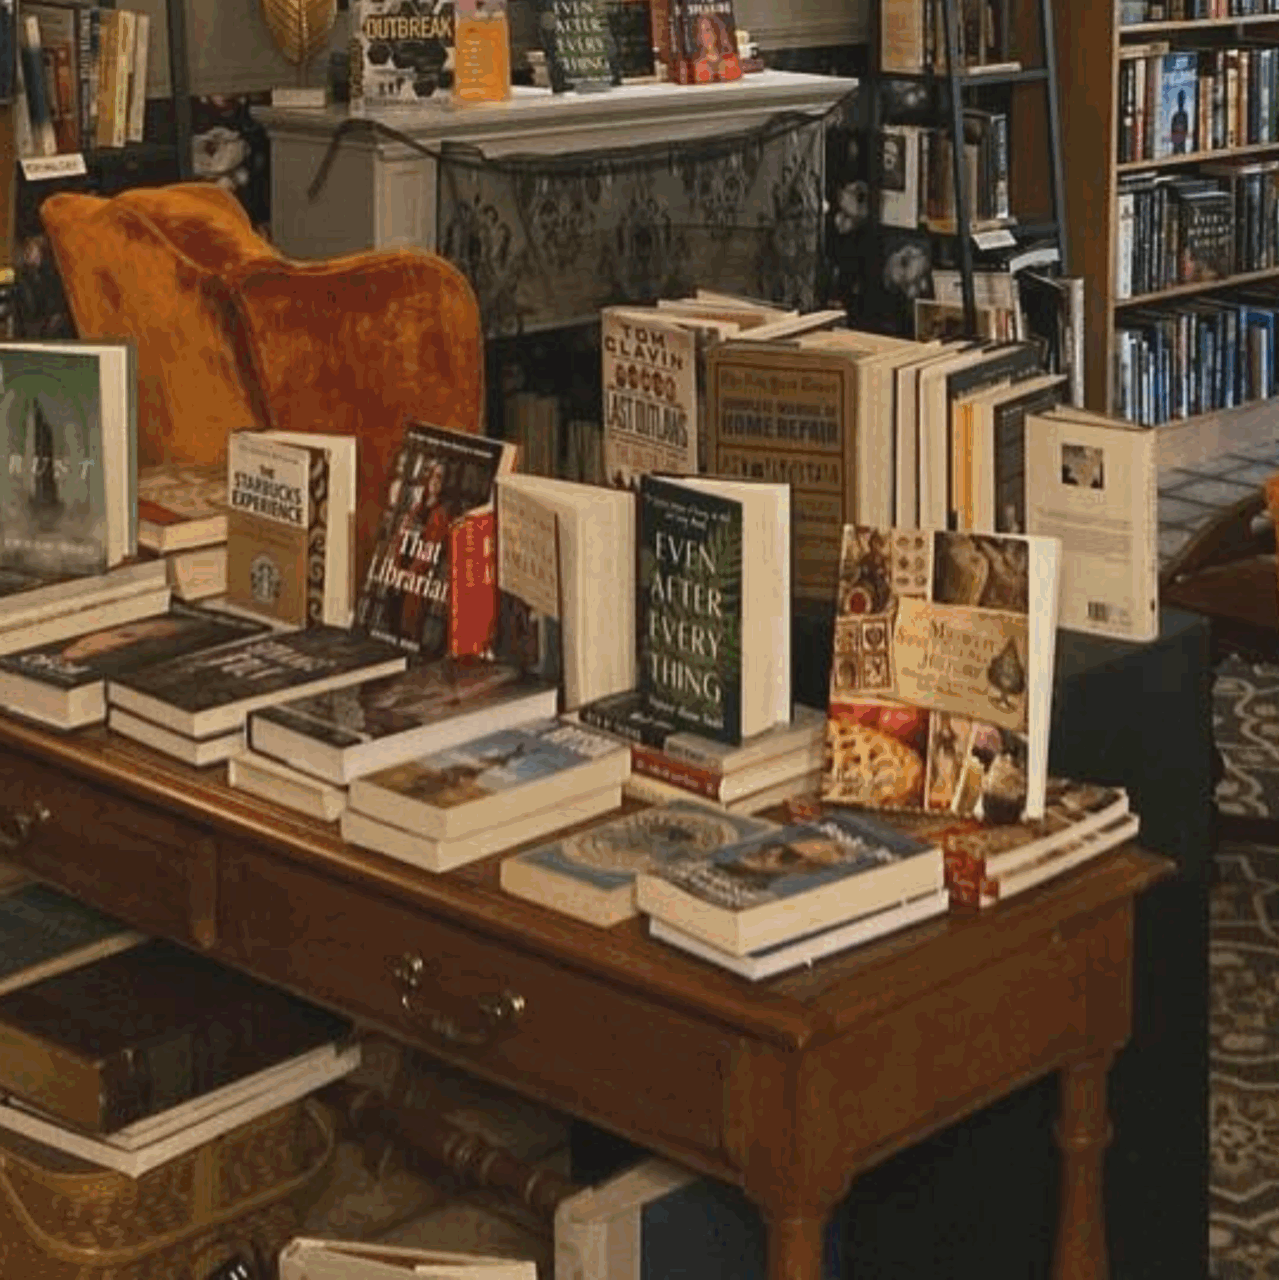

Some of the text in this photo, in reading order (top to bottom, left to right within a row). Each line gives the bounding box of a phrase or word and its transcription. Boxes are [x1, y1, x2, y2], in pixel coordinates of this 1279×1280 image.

[366, 16, 452, 39] OUTBREAK
[604, 335, 683, 371] CLAVIN
[620, 322, 665, 349] TOM
[606, 389, 688, 449] LAST OUTLAWS
[722, 413, 774, 437] HOME
[9, 454, 95, 480] RUST
[234, 471, 302, 505] STARBUCKS
[232, 489, 303, 524] EXPERIENCE
[400, 527, 442, 565] That
[655, 531, 716, 575] EVEN
[651, 569, 722, 619] AFTER
[650, 610, 722, 660] EVERY
[651, 651, 721, 704] THING
